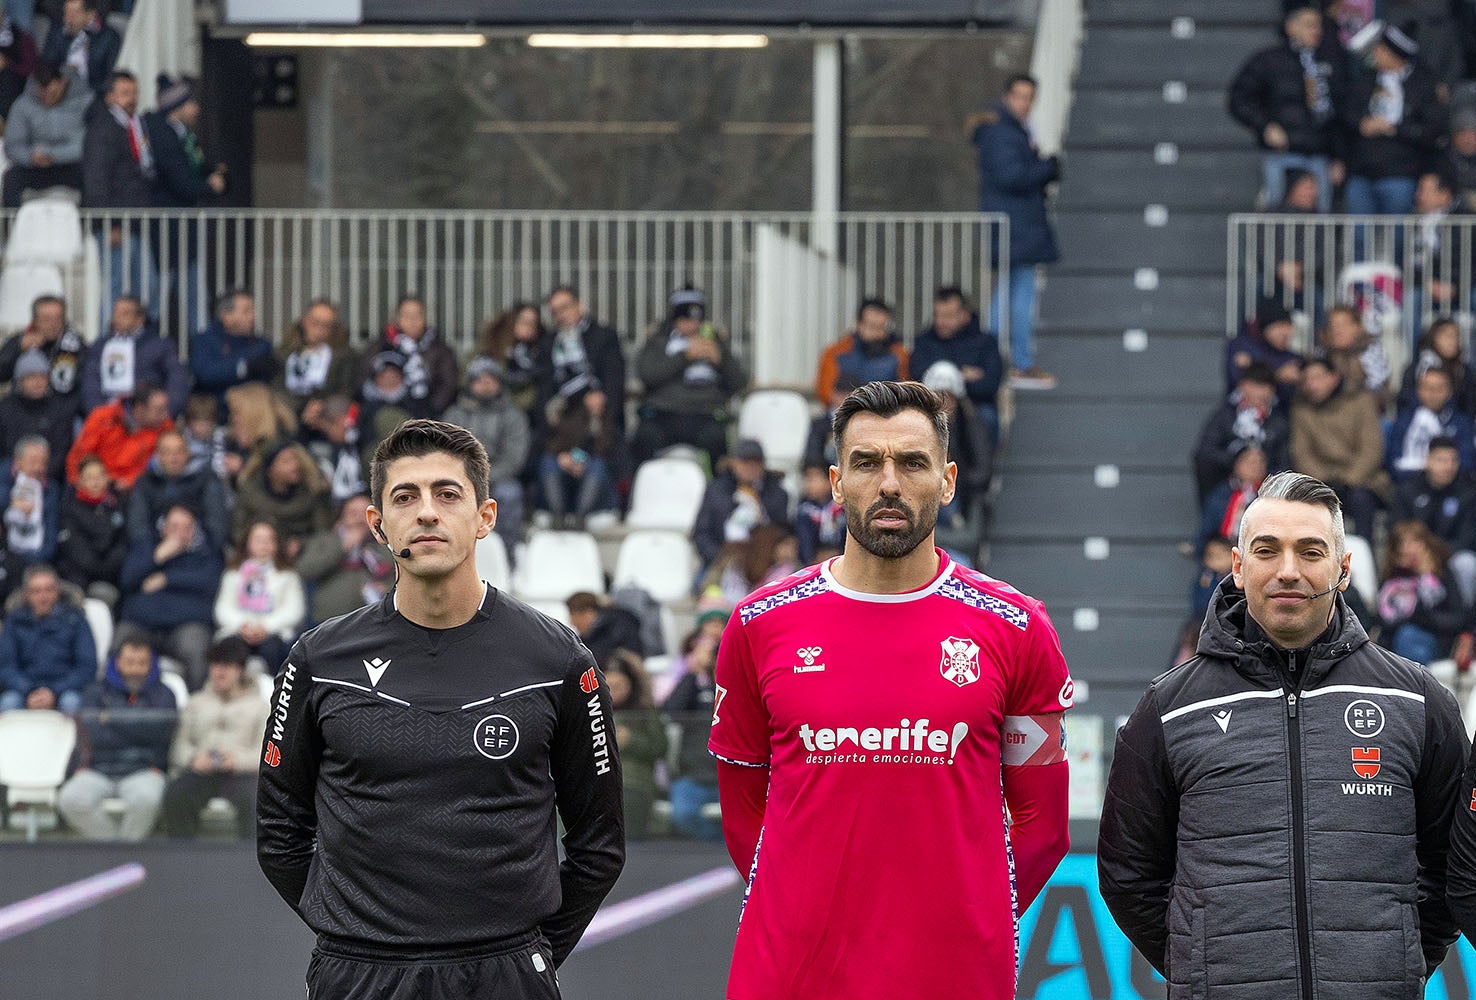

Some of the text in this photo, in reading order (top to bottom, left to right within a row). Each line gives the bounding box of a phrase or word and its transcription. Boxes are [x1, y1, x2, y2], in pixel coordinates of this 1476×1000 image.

[272, 662, 297, 741] WÜRTH
[587, 694, 611, 776] WÜRTH
[1006, 732, 1027, 745] CDT
[806, 753, 945, 766] despierta emociones
[1341, 783, 1393, 796] WÜRTH
